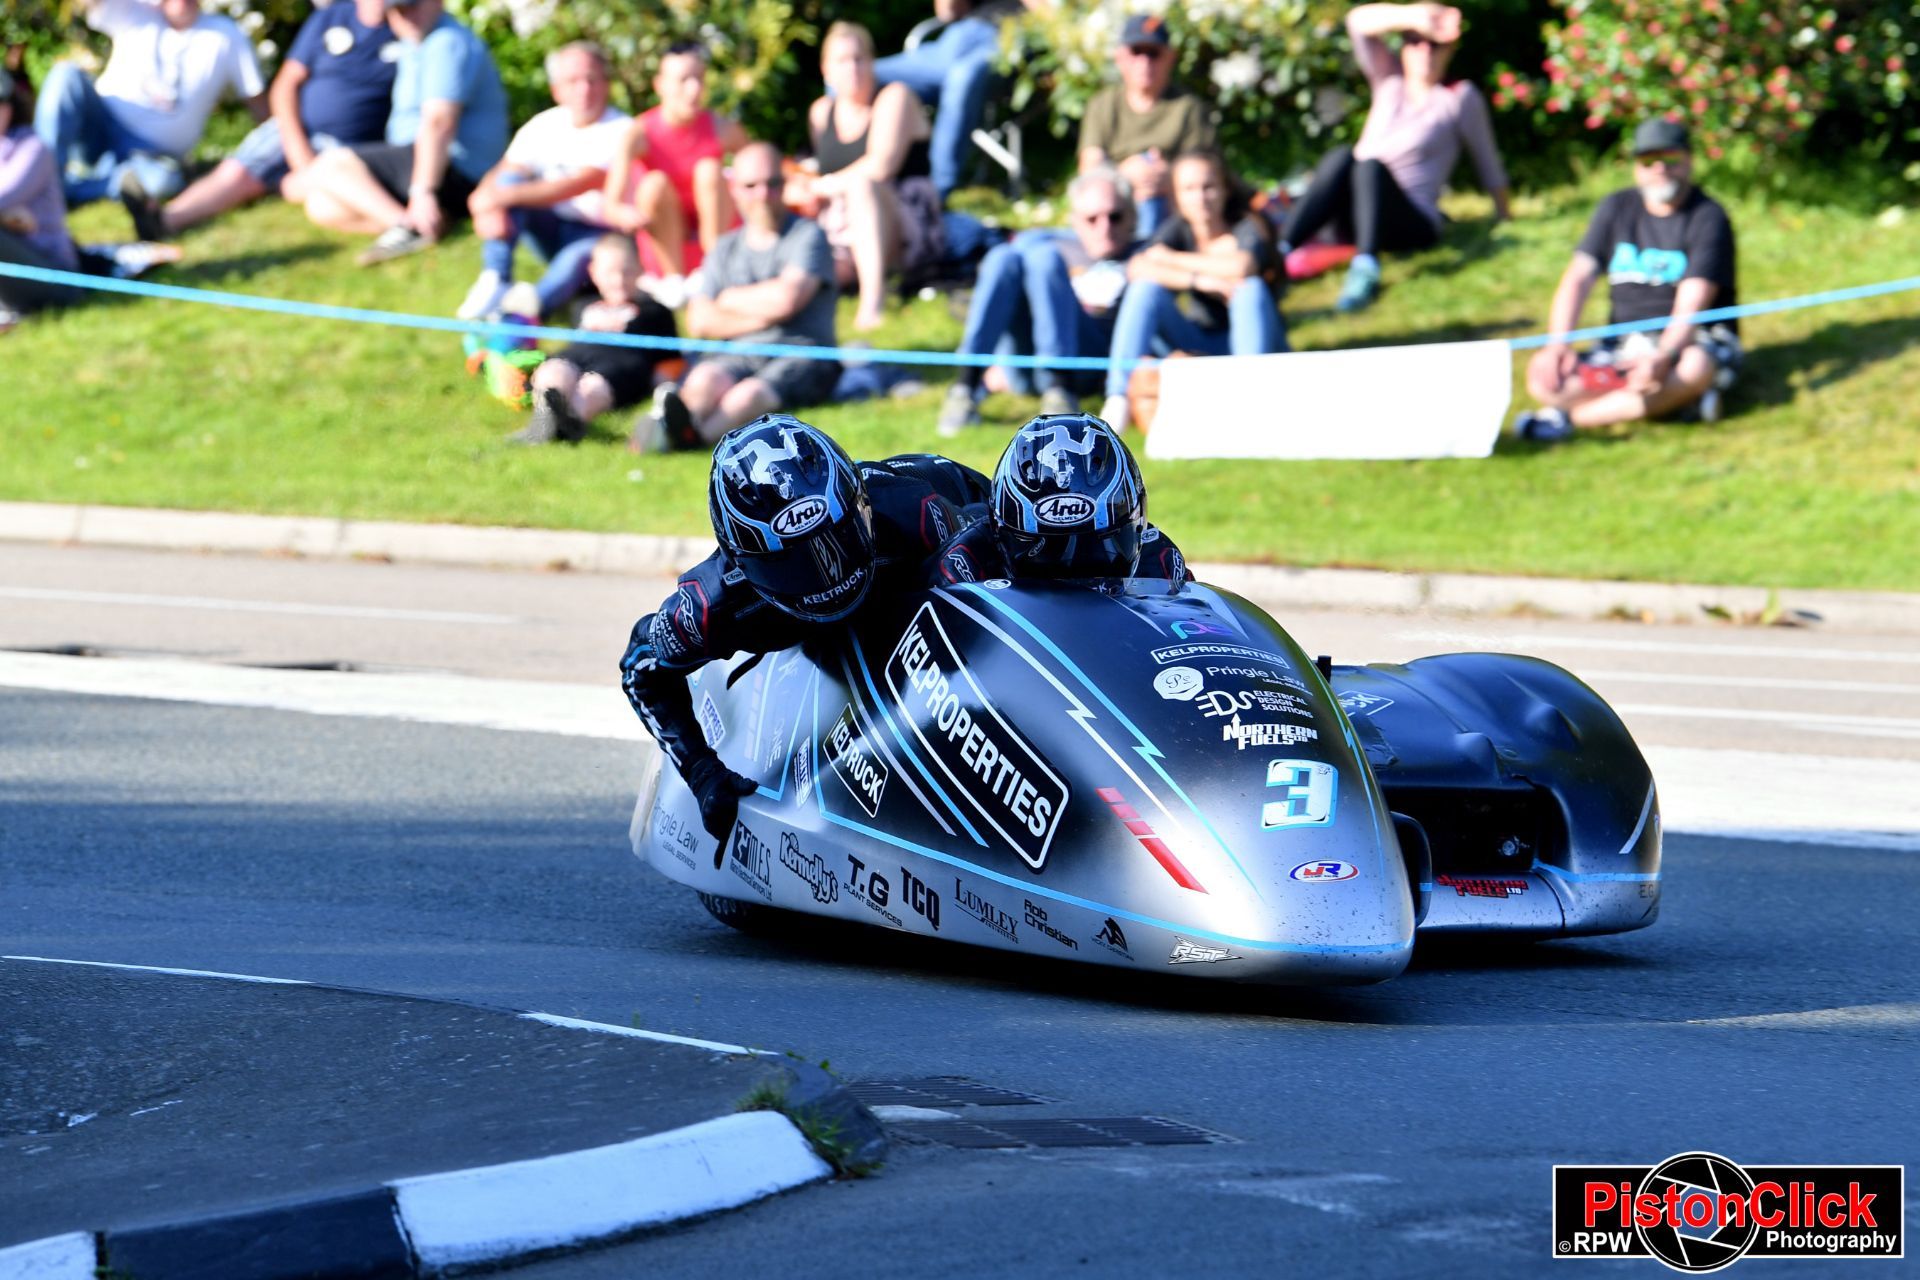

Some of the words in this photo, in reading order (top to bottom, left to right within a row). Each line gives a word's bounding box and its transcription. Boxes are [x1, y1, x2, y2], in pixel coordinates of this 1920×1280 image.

[778, 501, 821, 532] Arai
[1040, 500, 1087, 517] Arai
[803, 568, 865, 605] KELTRUCK
[1158, 645, 1285, 665] KELPROPERTIES
[1206, 666, 1269, 678] Pringle
[1271, 670, 1305, 688] Law
[1253, 690, 1308, 705] ELECTRICAL
[1257, 697, 1294, 706] DESIGN
[1261, 703, 1313, 718] SOLUTIONS
[705, 697, 724, 742] EXPRESS
[899, 624, 1051, 837] KELPROPERTIES
[1223, 717, 1318, 740] NORTHERN
[1238, 734, 1294, 750] FUELS
[831, 717, 883, 804] KELTRUCK
[1260, 758, 1338, 832] 3
[677, 821, 699, 854] Law
[844, 882, 866, 903] PLANT
[866, 899, 903, 927] SERVICES
[955, 876, 1019, 936] LUMLEY
[1024, 899, 1047, 921] Rob
[1025, 912, 1078, 951] Christian
